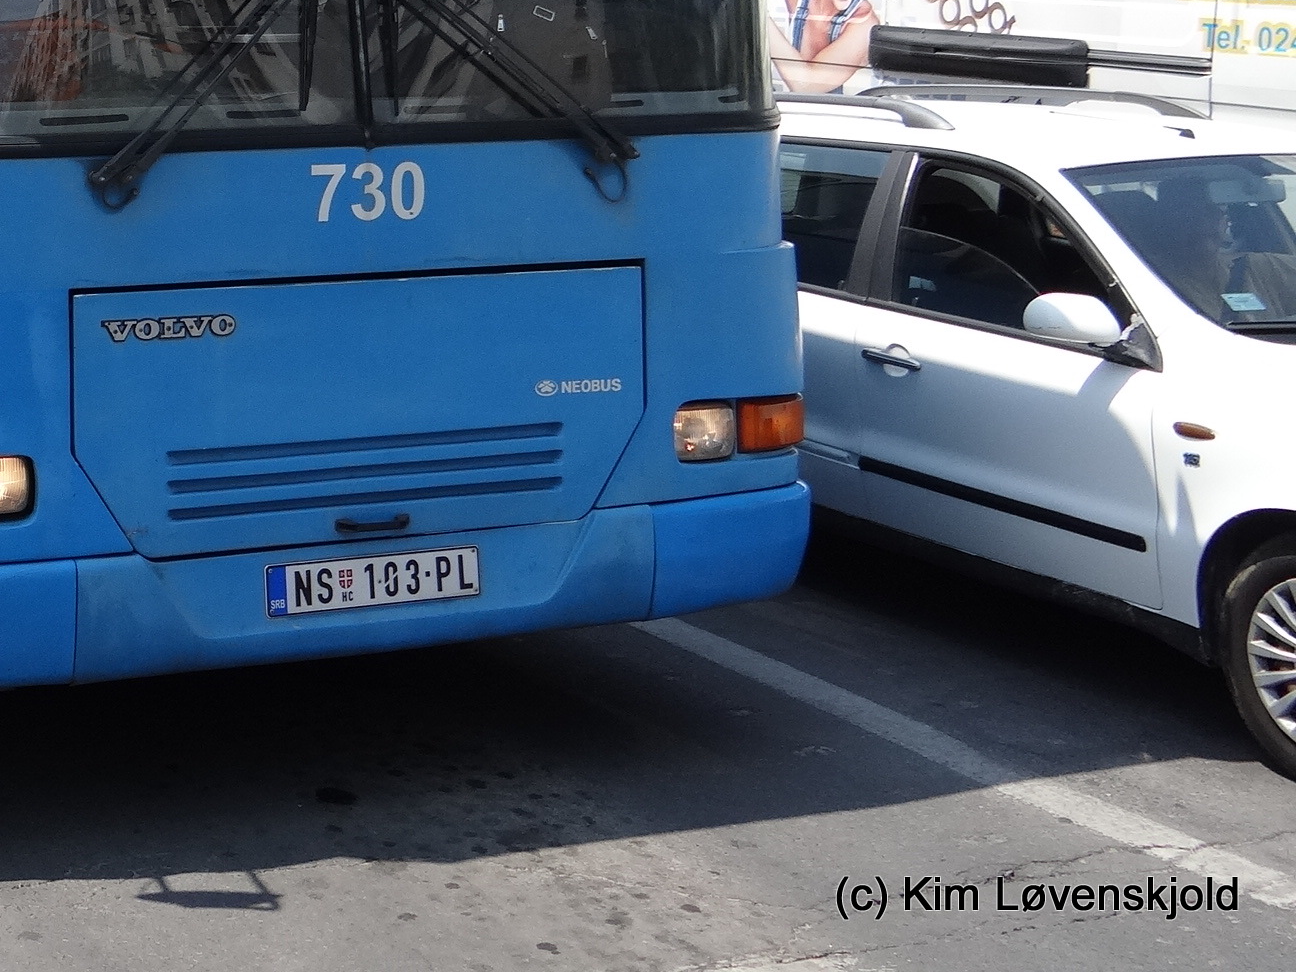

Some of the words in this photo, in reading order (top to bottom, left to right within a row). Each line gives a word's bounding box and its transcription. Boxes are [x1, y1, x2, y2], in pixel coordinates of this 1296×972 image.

[1202, 22, 1246, 51] Tel.
[310, 160, 426, 223] 730
[100, 313, 237, 343] VOLVO
[561, 378, 623, 395] NEOBUS
[294, 567, 334, 608] NS
[270, 598, 286, 610] SRB
